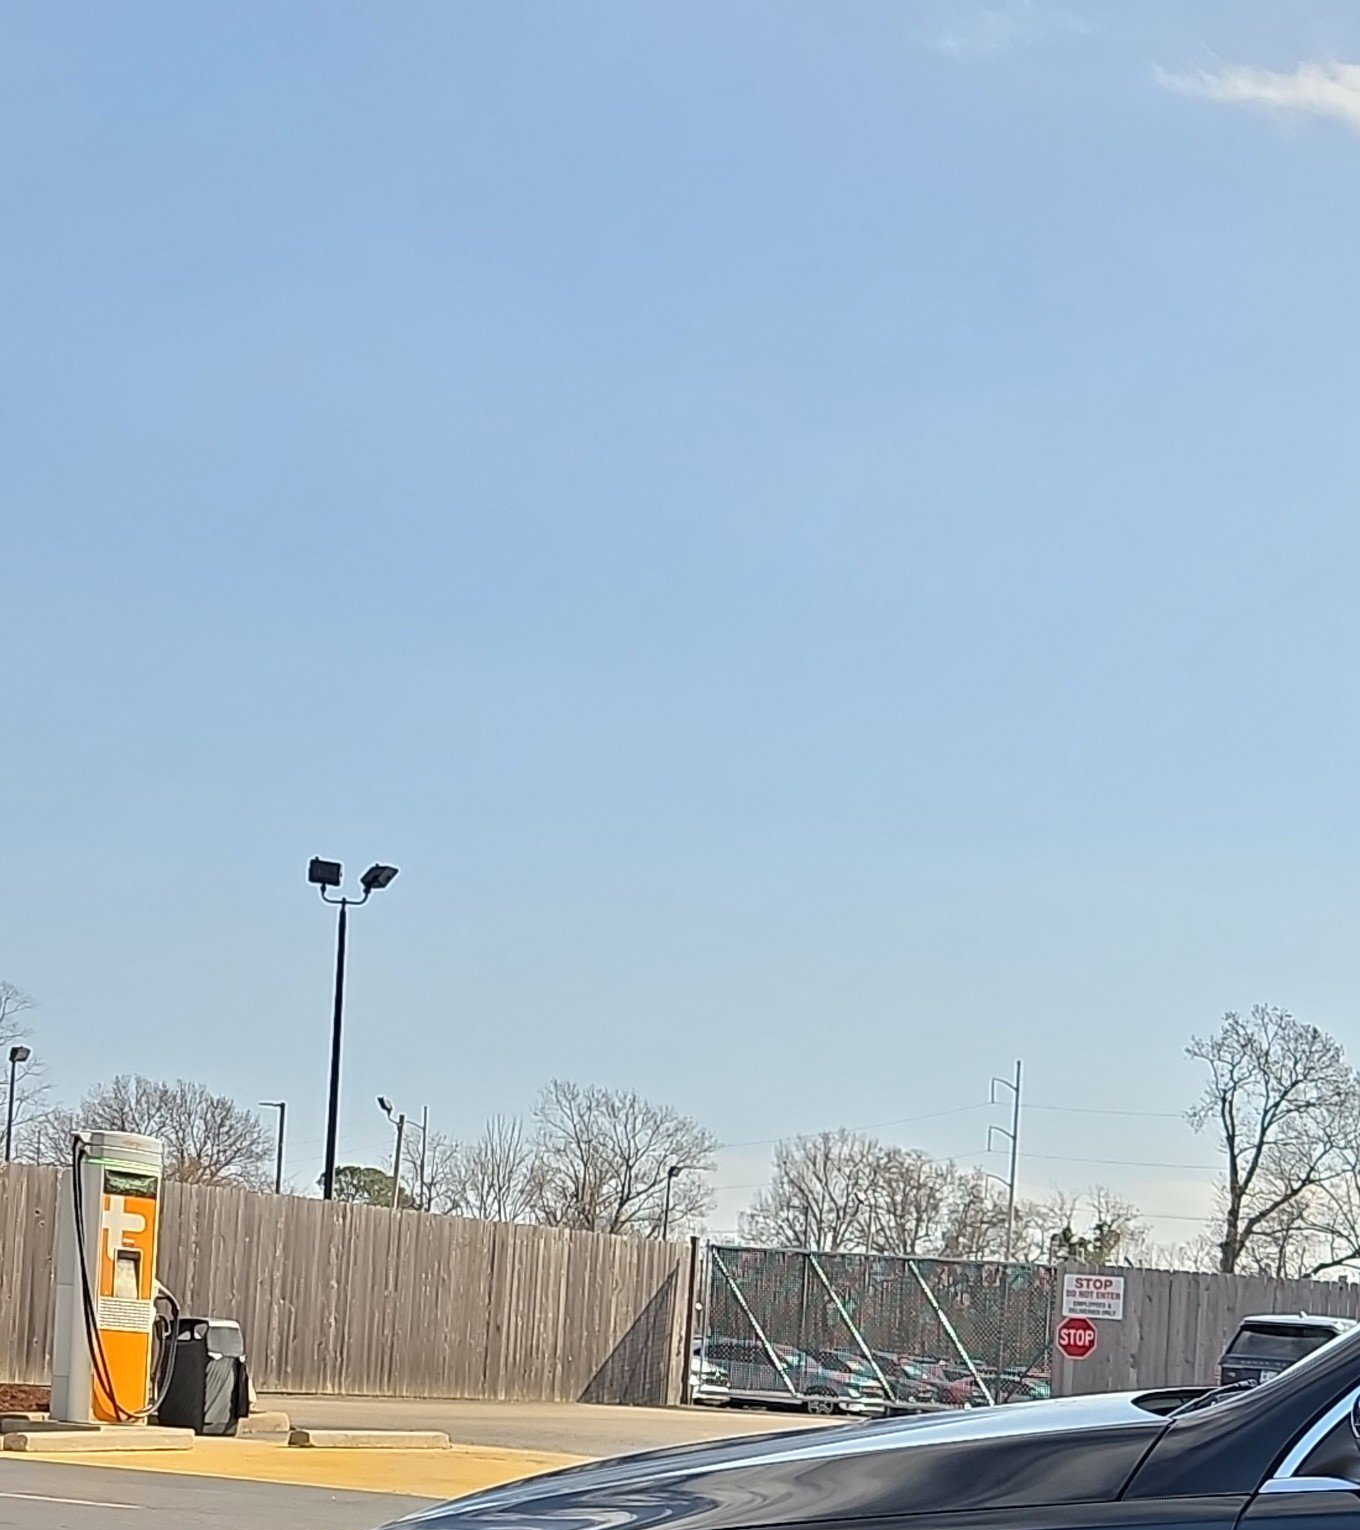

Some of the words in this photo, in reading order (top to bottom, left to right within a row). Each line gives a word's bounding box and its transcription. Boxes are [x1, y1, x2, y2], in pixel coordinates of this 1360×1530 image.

[1075, 1277, 1113, 1290] STOP
[1066, 1289, 1077, 1298] DO
[1078, 1290, 1094, 1299] NOT
[1096, 1291, 1120, 1300] ENTER
[1059, 1328, 1094, 1347] STOP
